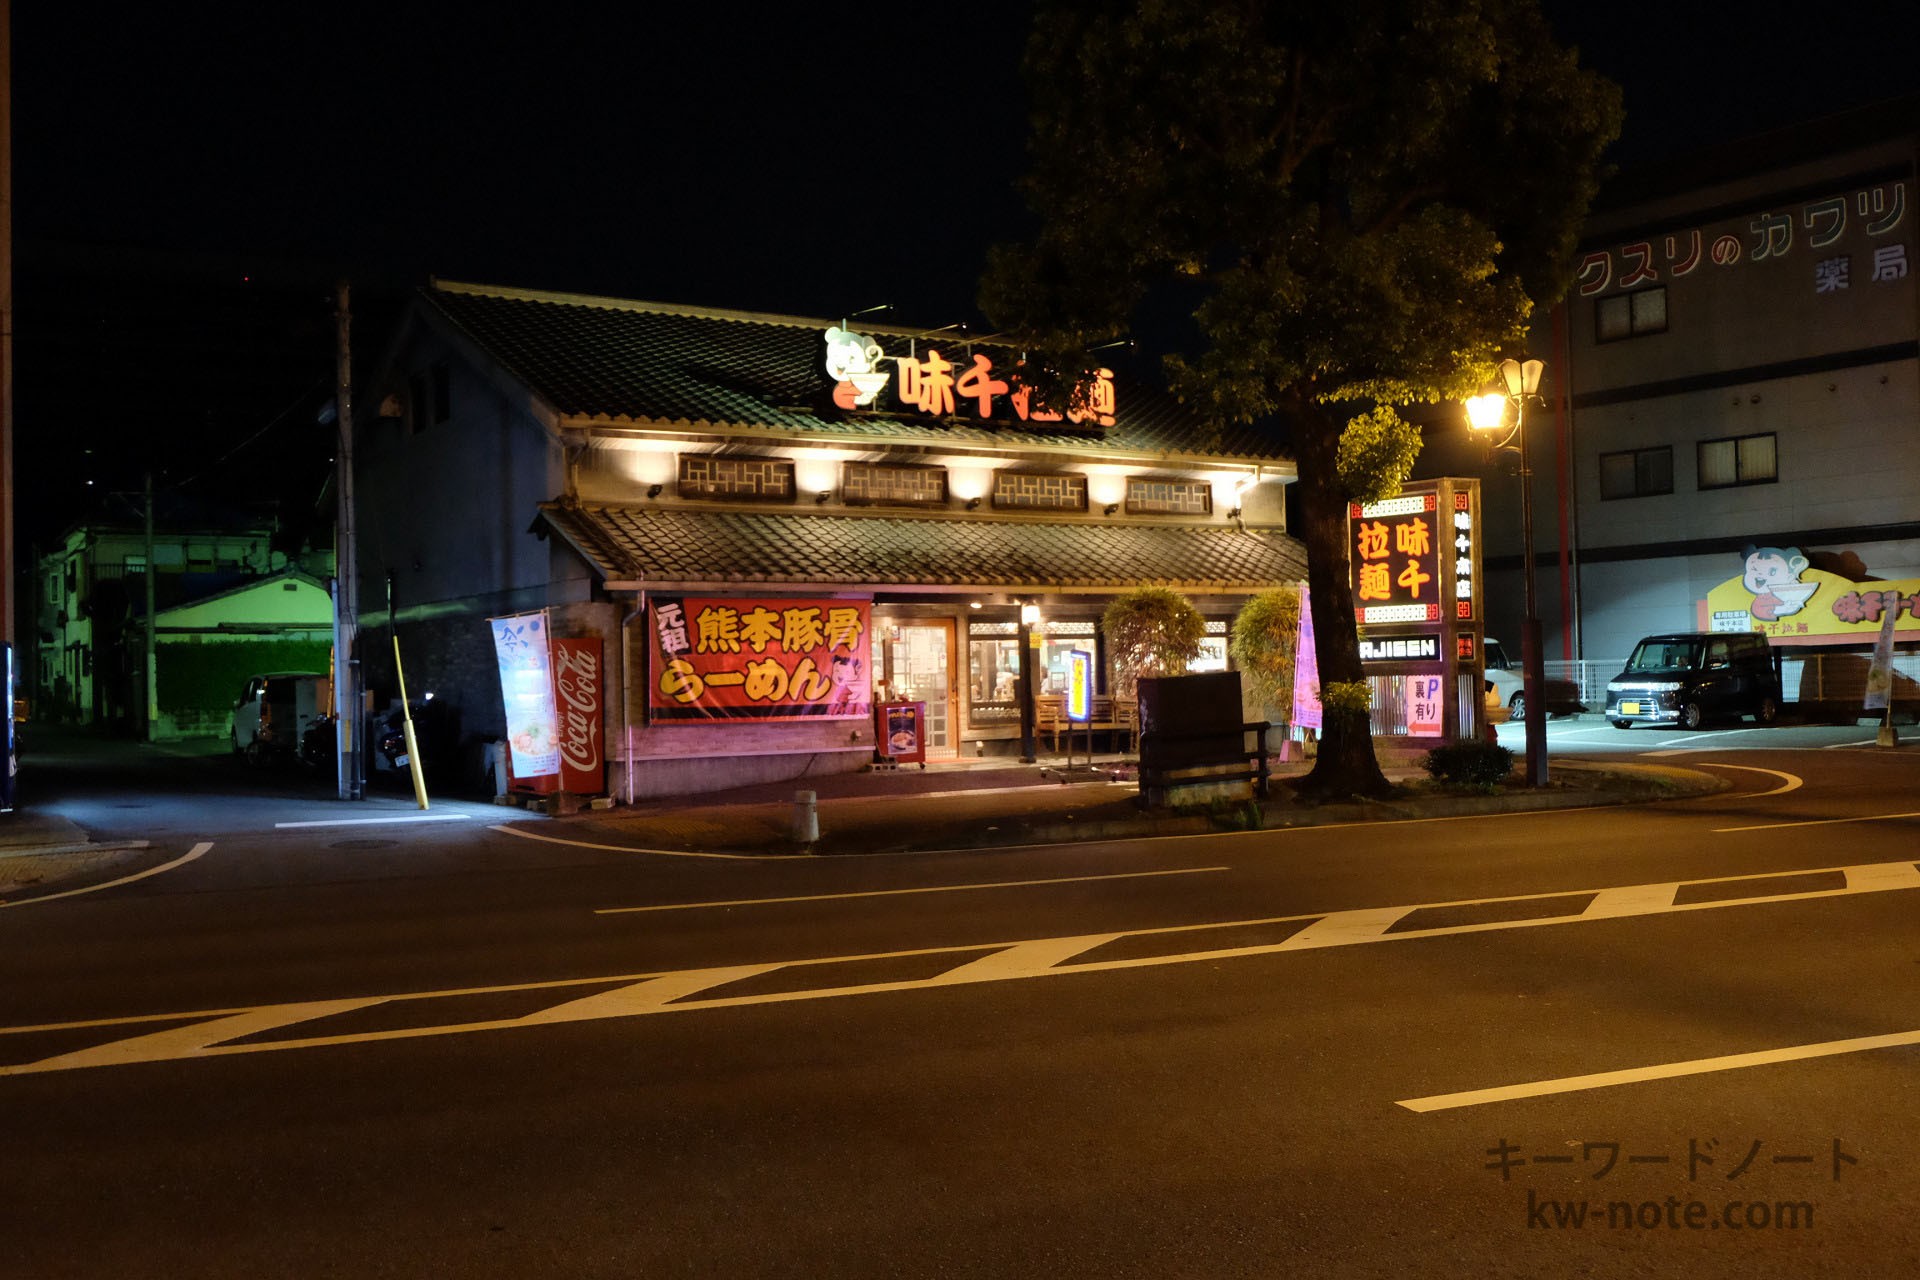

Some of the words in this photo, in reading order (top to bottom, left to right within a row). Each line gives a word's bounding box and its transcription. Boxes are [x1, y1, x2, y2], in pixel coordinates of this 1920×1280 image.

[1577, 183, 1905, 297] クスリのカワツ
[1814, 243, 1908, 294] 薬局
[1395, 516, 1431, 599] 味千
[657, 602, 690, 654] 元祖
[695, 604, 865, 655] 熊本豚骨
[1359, 639, 1436, 659] AJISEN
[658, 656, 833, 705] らーめん
[1414, 702, 1436, 721] 有り
